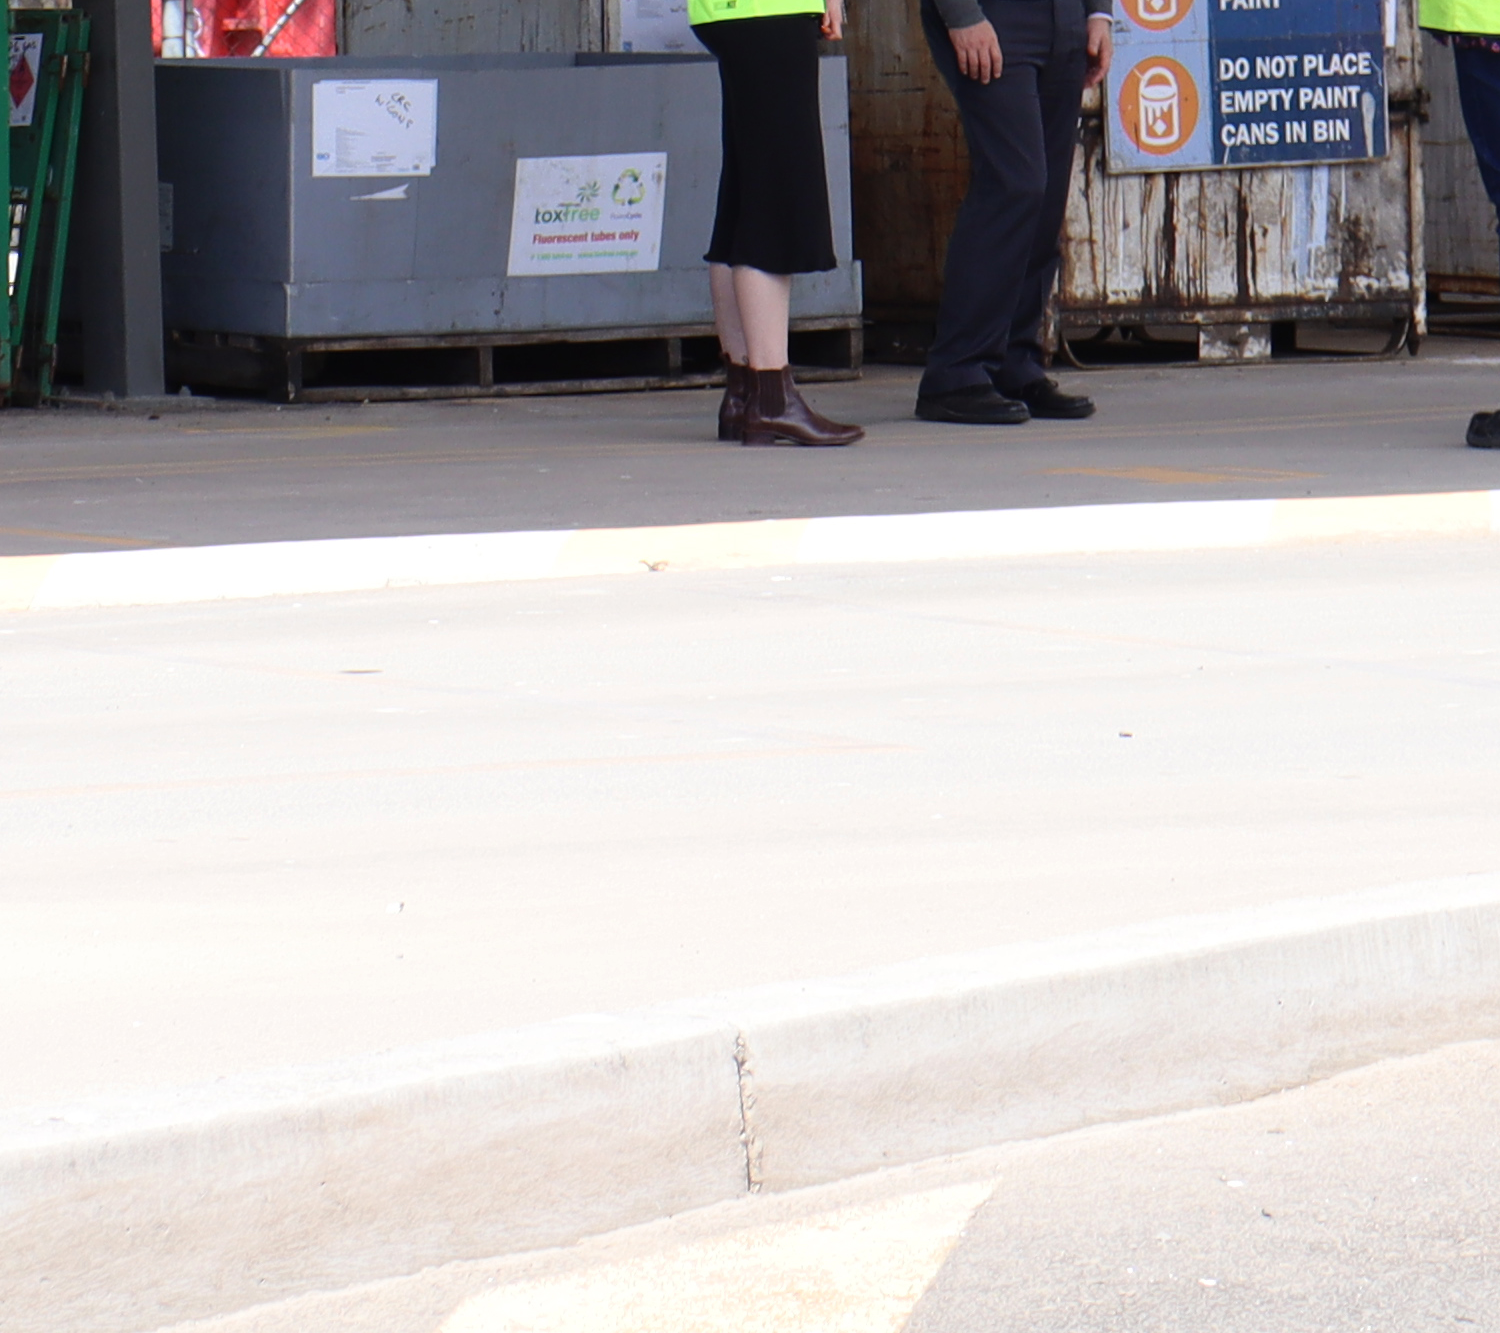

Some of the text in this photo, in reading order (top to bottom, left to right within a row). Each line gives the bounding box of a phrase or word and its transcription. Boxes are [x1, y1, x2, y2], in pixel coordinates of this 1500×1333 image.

[1219, 52, 1371, 81] DO NOT PLACE
[1220, 86, 1360, 114] EMPTY PAINT
[1221, 120, 1350, 147] CANS IN BIN
[535, 205, 599, 224] toxfree
[532, 230, 640, 245] Fluorescent tubes only
